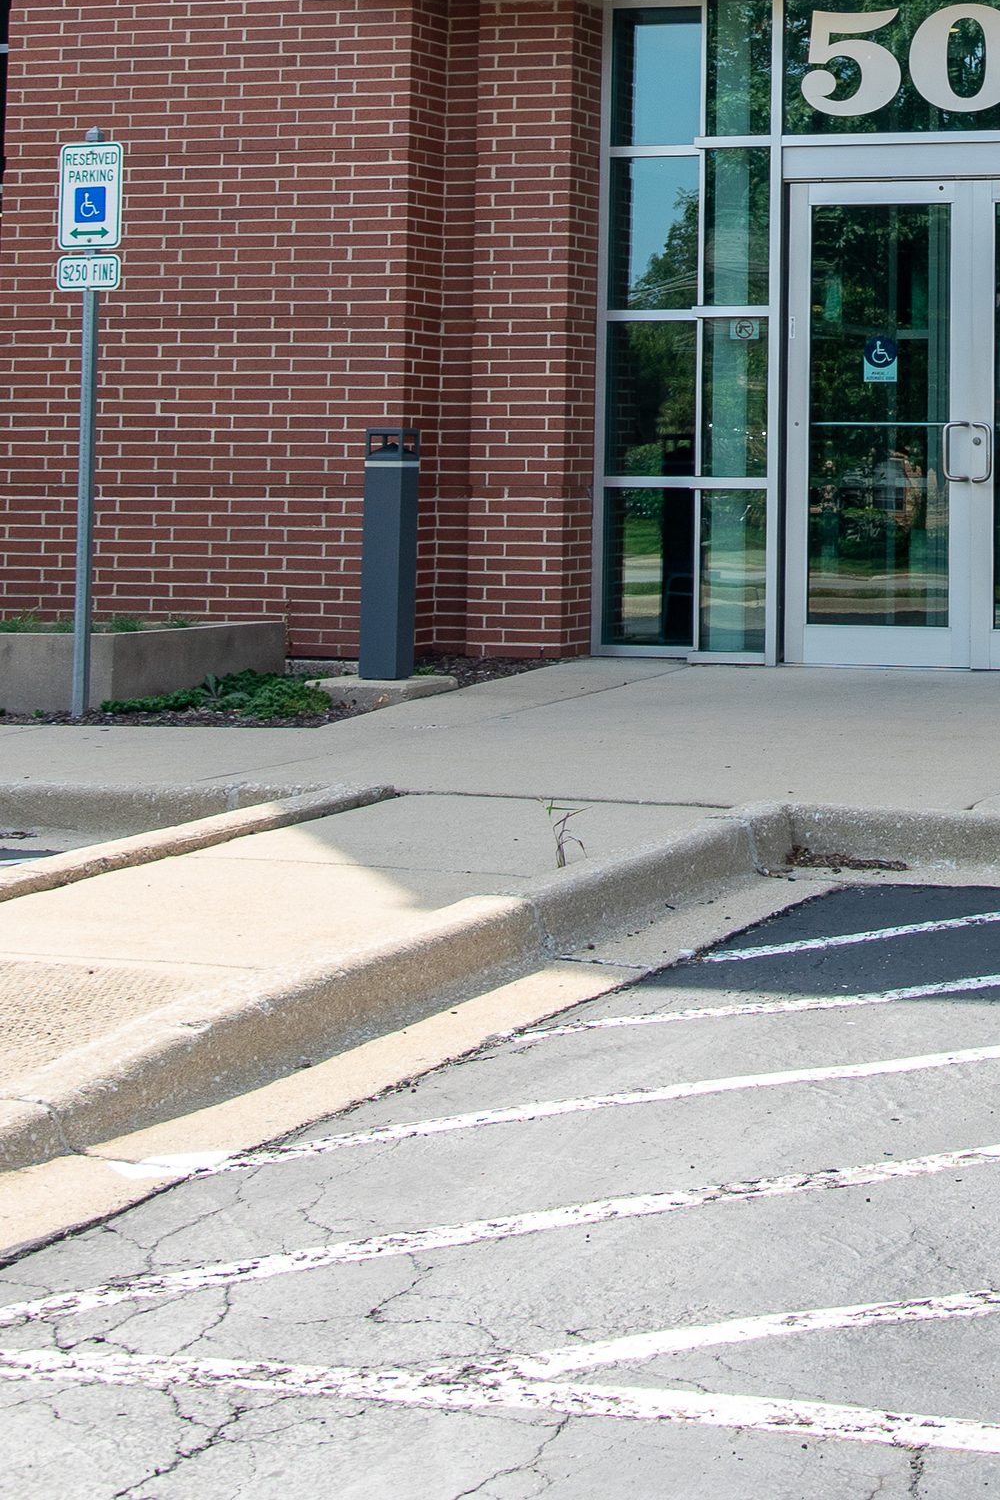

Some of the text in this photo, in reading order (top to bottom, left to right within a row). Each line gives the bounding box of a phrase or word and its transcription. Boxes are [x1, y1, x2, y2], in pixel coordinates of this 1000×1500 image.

[65, 152, 118, 166] RESERVED
[68, 169, 114, 184] PARKING
[62, 263, 115, 282] $250 FINE
